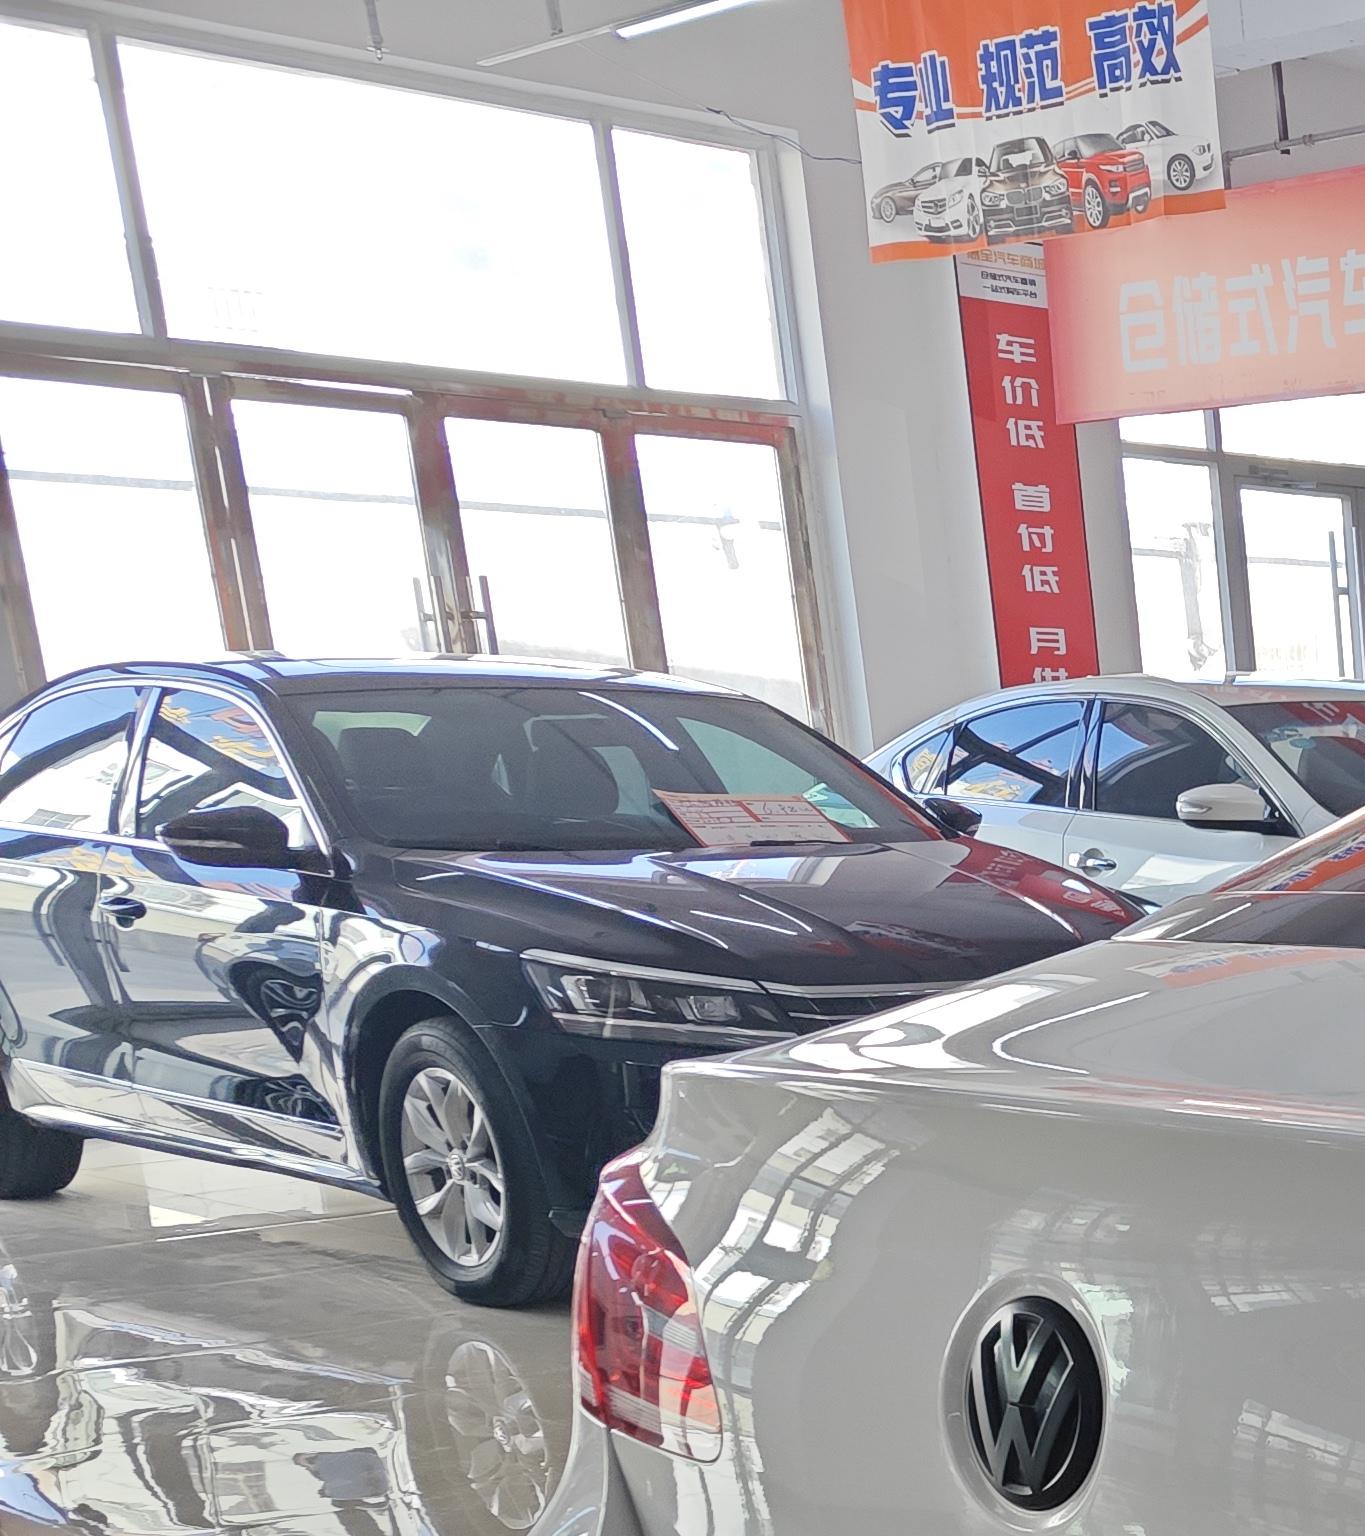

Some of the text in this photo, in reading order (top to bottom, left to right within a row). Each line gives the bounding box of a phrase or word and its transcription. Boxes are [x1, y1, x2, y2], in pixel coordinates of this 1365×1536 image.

[871, 1, 1183, 137] 专业 规范 高效
[995, 333, 1046, 449] 车价低
[1011, 482, 1061, 594] 首付低
